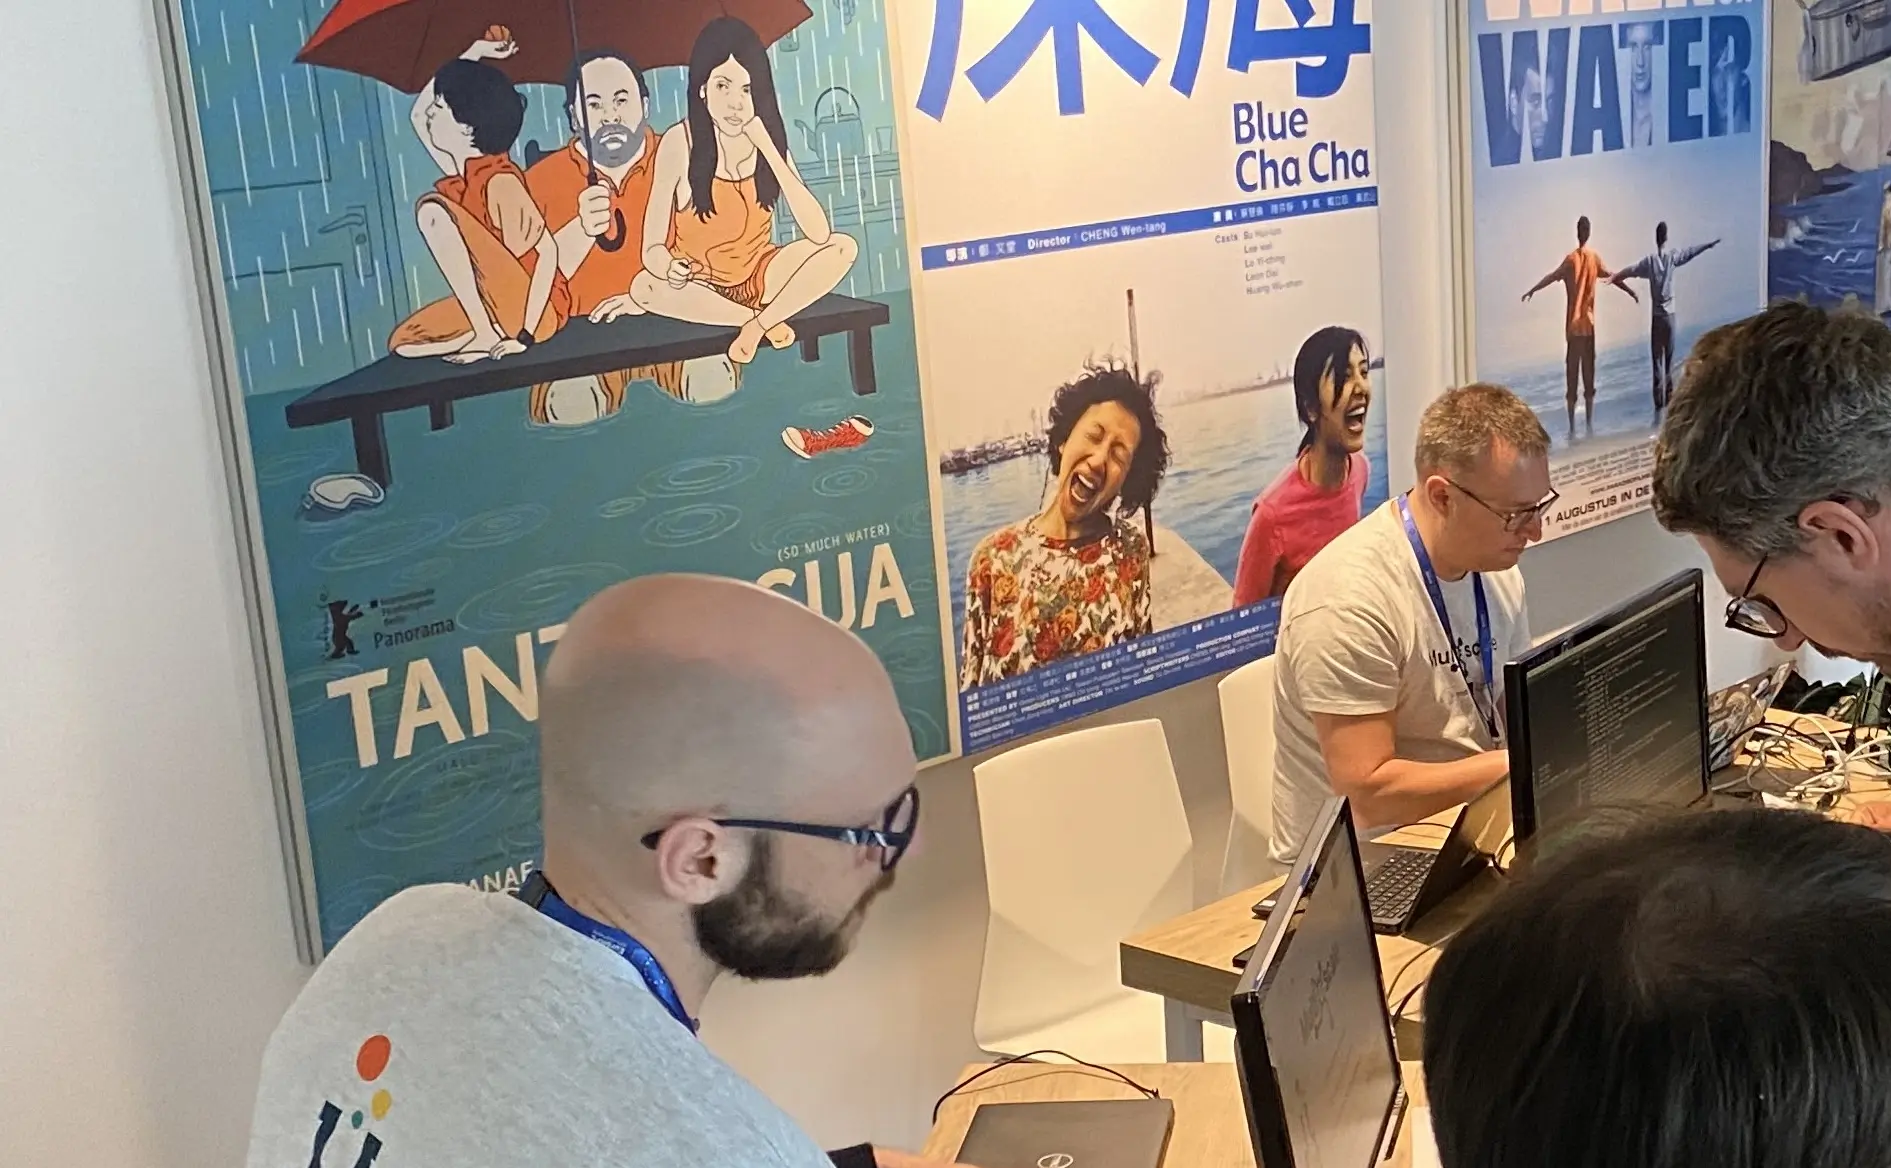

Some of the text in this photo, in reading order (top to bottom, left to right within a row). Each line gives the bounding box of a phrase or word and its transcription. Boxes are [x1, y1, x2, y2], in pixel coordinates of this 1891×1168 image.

[1478, 15, 1752, 167] WATER
[1233, 102, 1309, 146] Blue
[1235, 141, 1371, 193] Cha Cha
[1027, 233, 1072, 251] Director
[1080, 226, 1119, 243] CHENG
[1555, 495, 1618, 524] AUGUSTUS
[1621, 489, 1633, 502] IN
[1636, 485, 1650, 498] DE
[777, 522, 892, 562] (SO MUCH WATER)
[374, 618, 456, 650] Panorama
